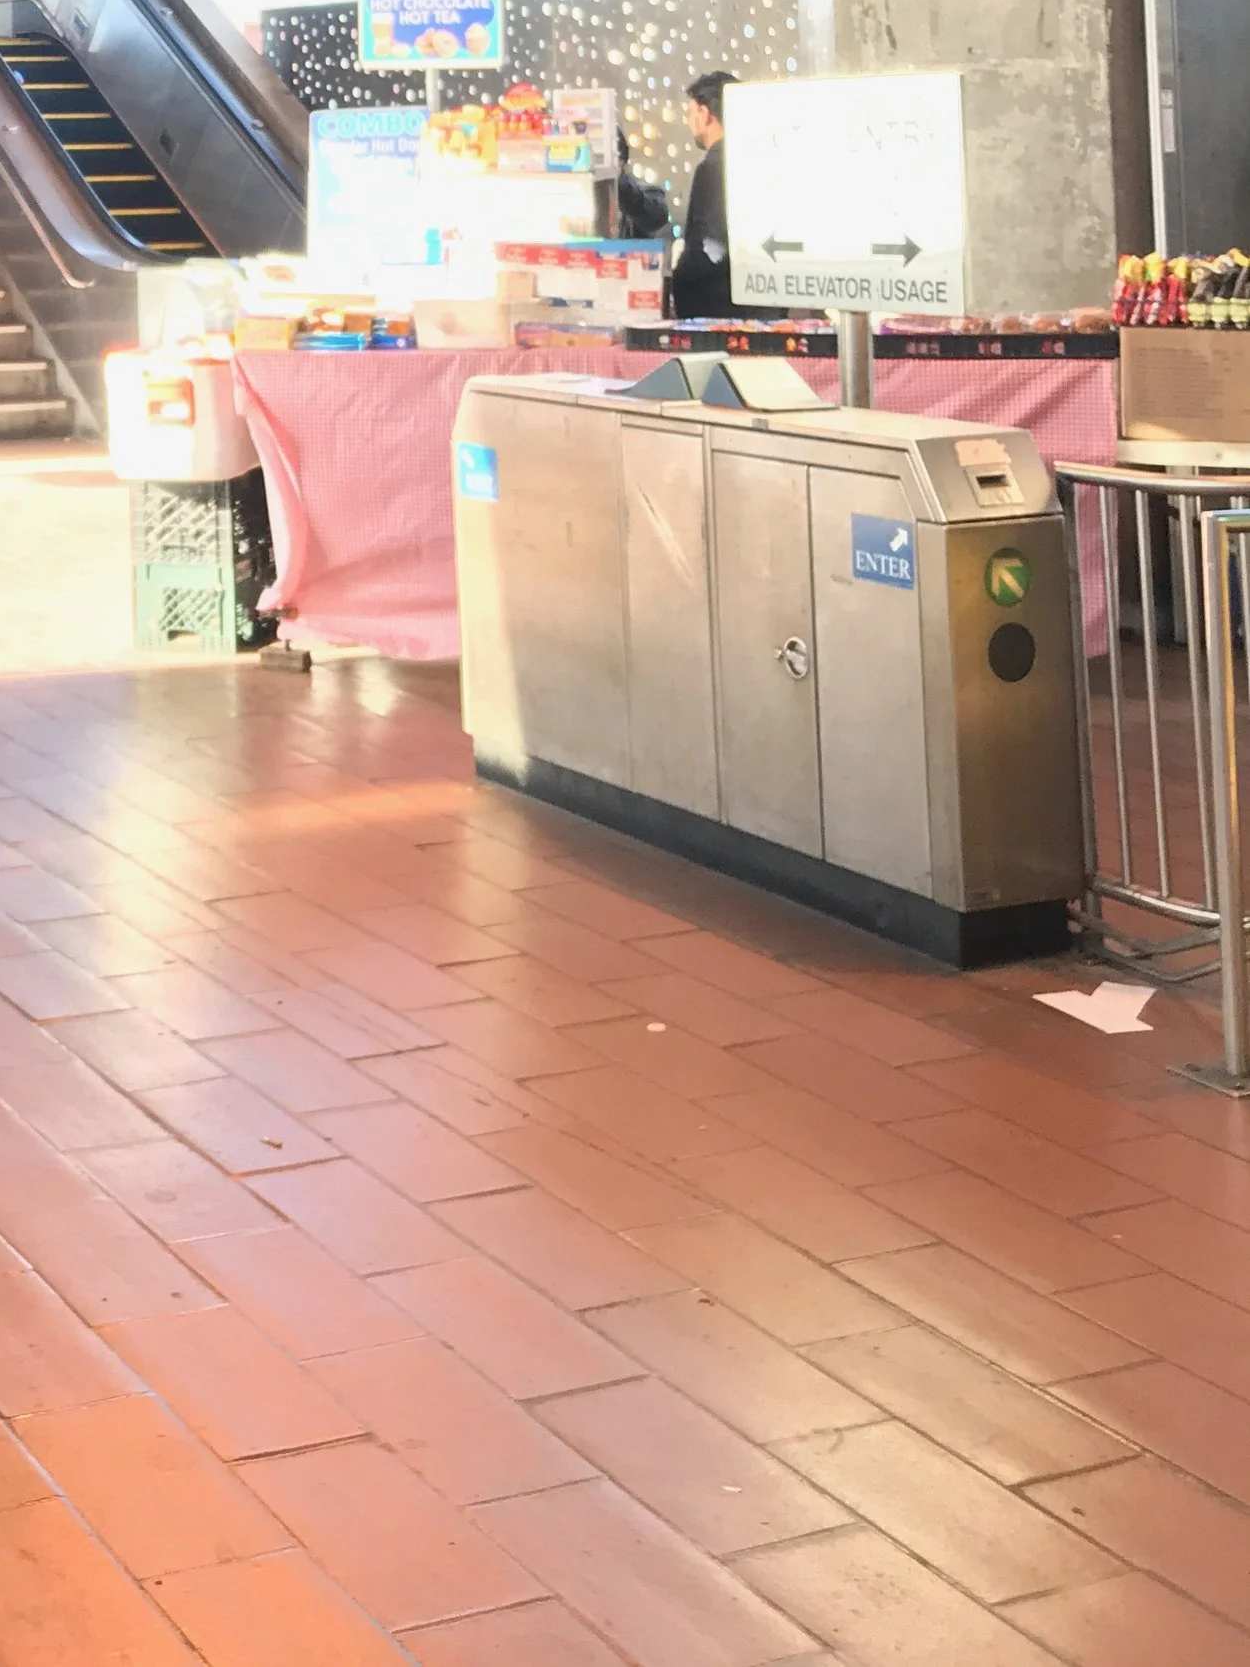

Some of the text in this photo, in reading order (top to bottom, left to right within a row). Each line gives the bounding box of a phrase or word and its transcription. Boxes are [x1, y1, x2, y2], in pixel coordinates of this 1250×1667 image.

[399, 10, 461, 25] HOT TEA
[745, 273, 948, 303] ADA ELEVATOR USAGE
[855, 549, 911, 581] ENTER
